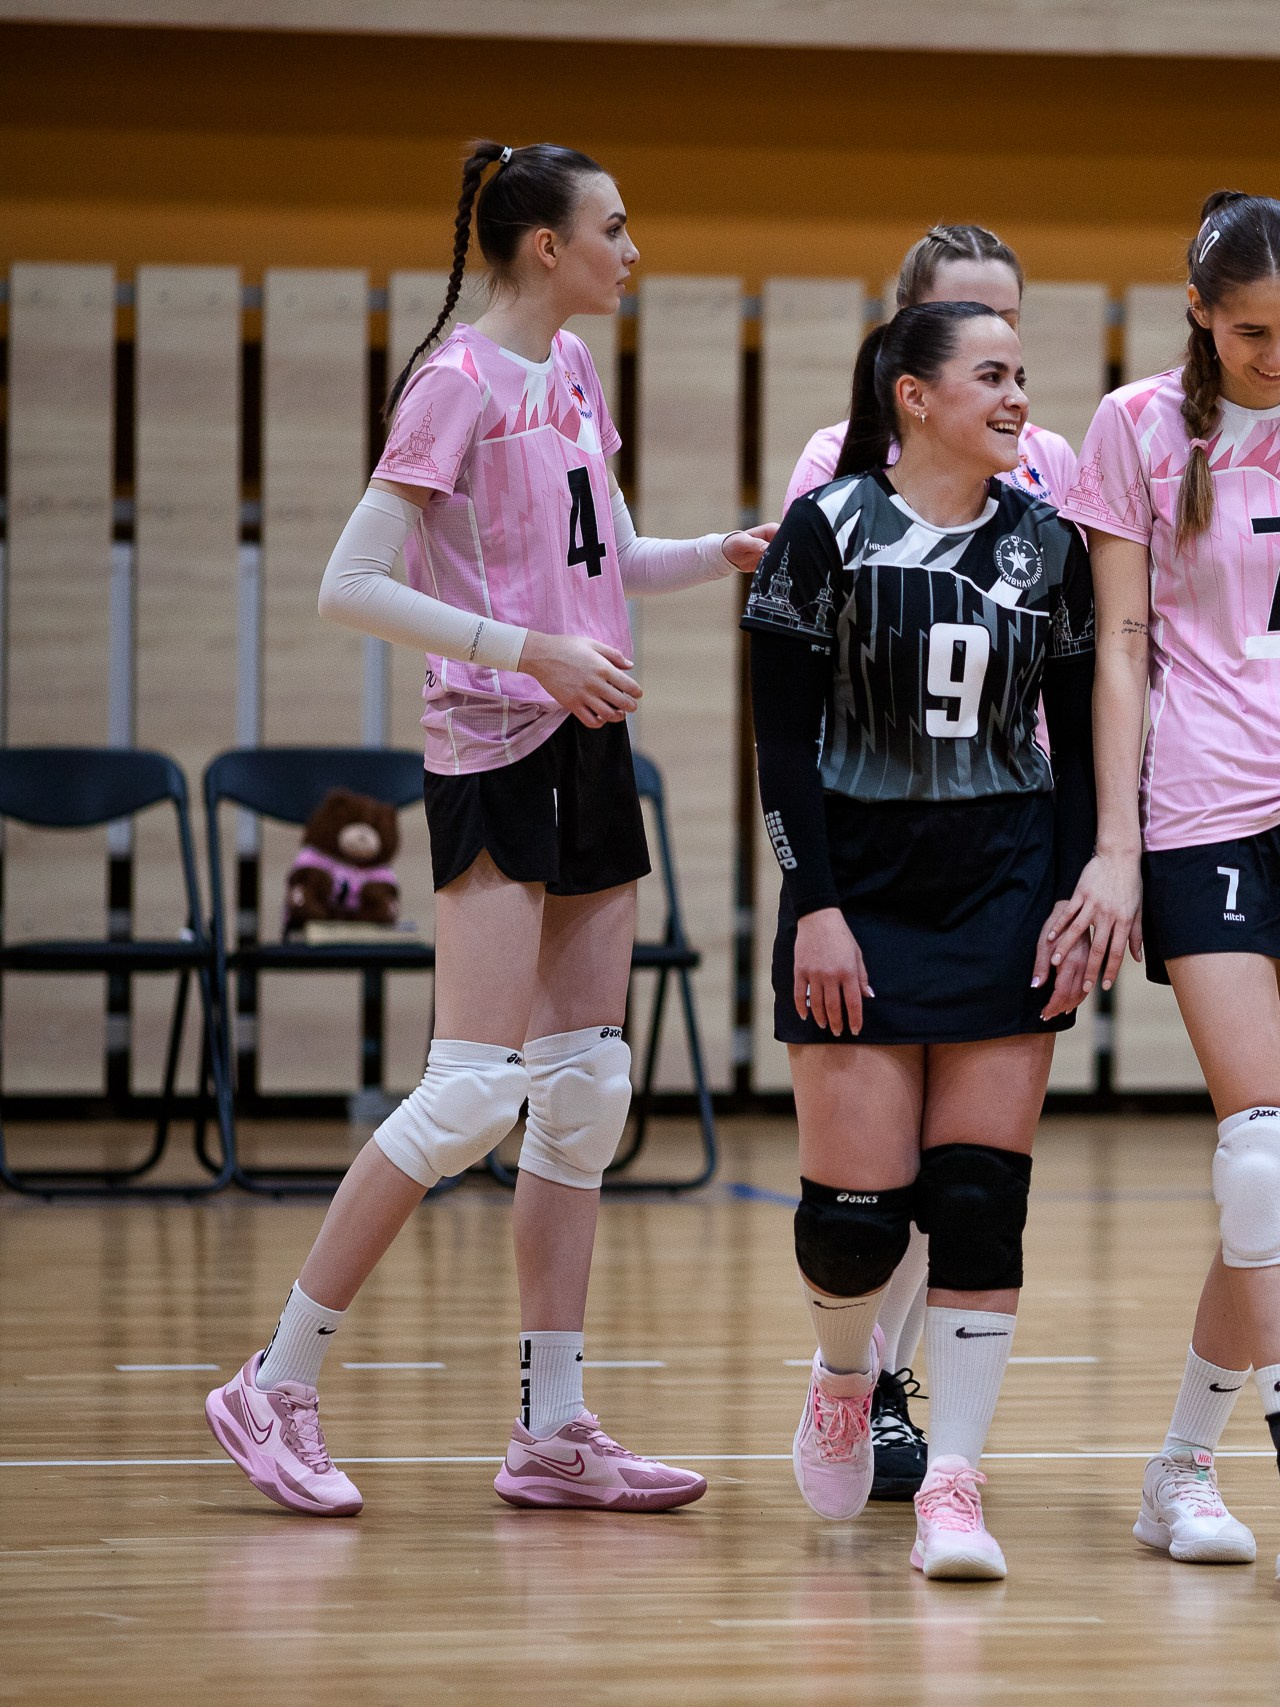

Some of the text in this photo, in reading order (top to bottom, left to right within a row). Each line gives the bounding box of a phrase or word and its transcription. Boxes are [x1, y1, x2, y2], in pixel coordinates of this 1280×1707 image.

[566, 465, 607, 579] 4
[925, 622, 991, 738] 9
[1217, 866, 1240, 910] 7
[1223, 913, 1246, 922] Hitch
[848, 1195, 879, 1204] asics
